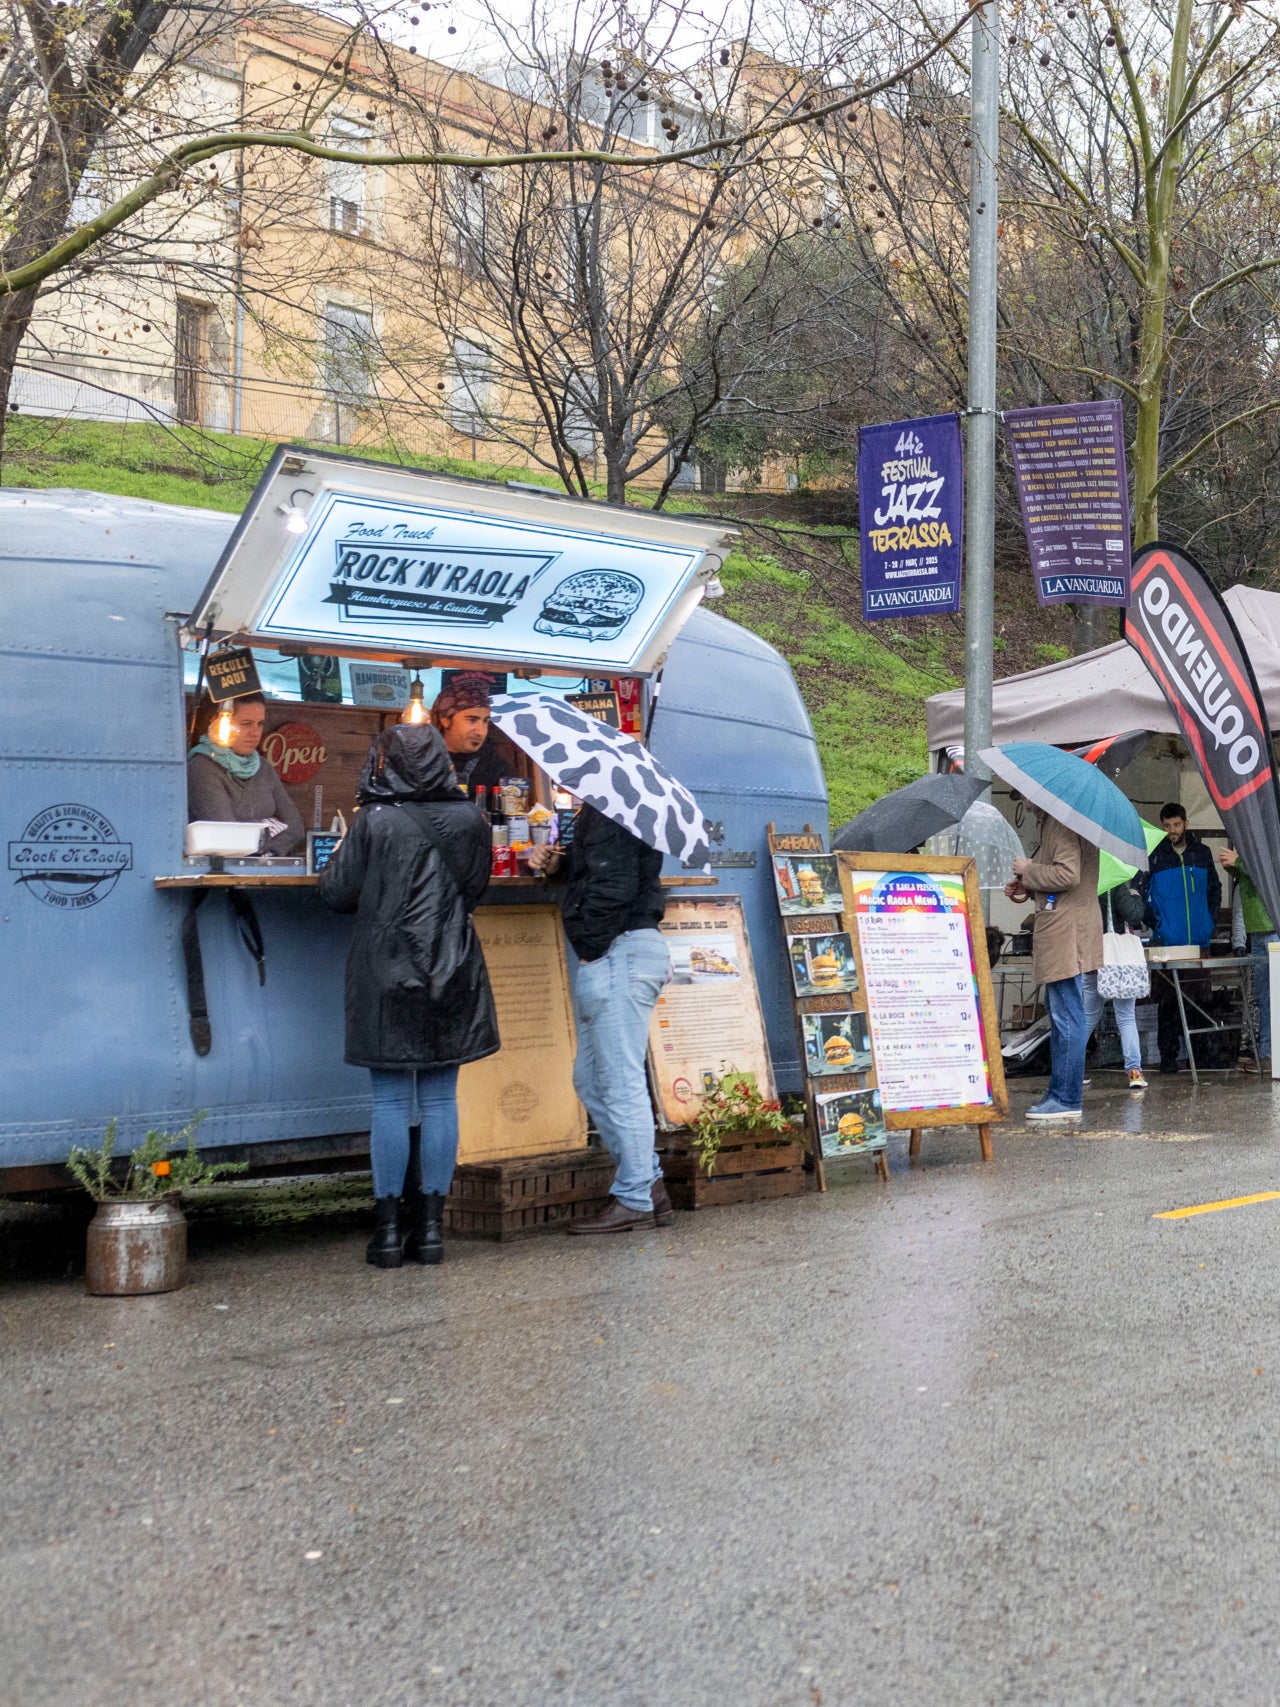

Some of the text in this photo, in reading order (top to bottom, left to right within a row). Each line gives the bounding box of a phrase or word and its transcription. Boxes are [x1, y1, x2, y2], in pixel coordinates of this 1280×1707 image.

[874, 477, 945, 526] JAZZ
[344, 522, 438, 540] Food Truck
[869, 521, 953, 553] TERRASSA
[332, 550, 532, 601] ROCK'N'RAOLA
[870, 586, 952, 608] LA VANGUARDIA
[1045, 578, 1123, 595] LA VANGUARDIA
[347, 590, 488, 616] Hamburgueses de Qualitat
[209, 656, 251, 677] RECULL
[221, 671, 247, 689] AQUI
[354, 672, 408, 689] HAMBURGERS
[262, 733, 329, 774] Open
[860, 894, 886, 906] MAGIC
[886, 894, 913, 906] RAOLA
[938, 897, 959, 906] TOUR
